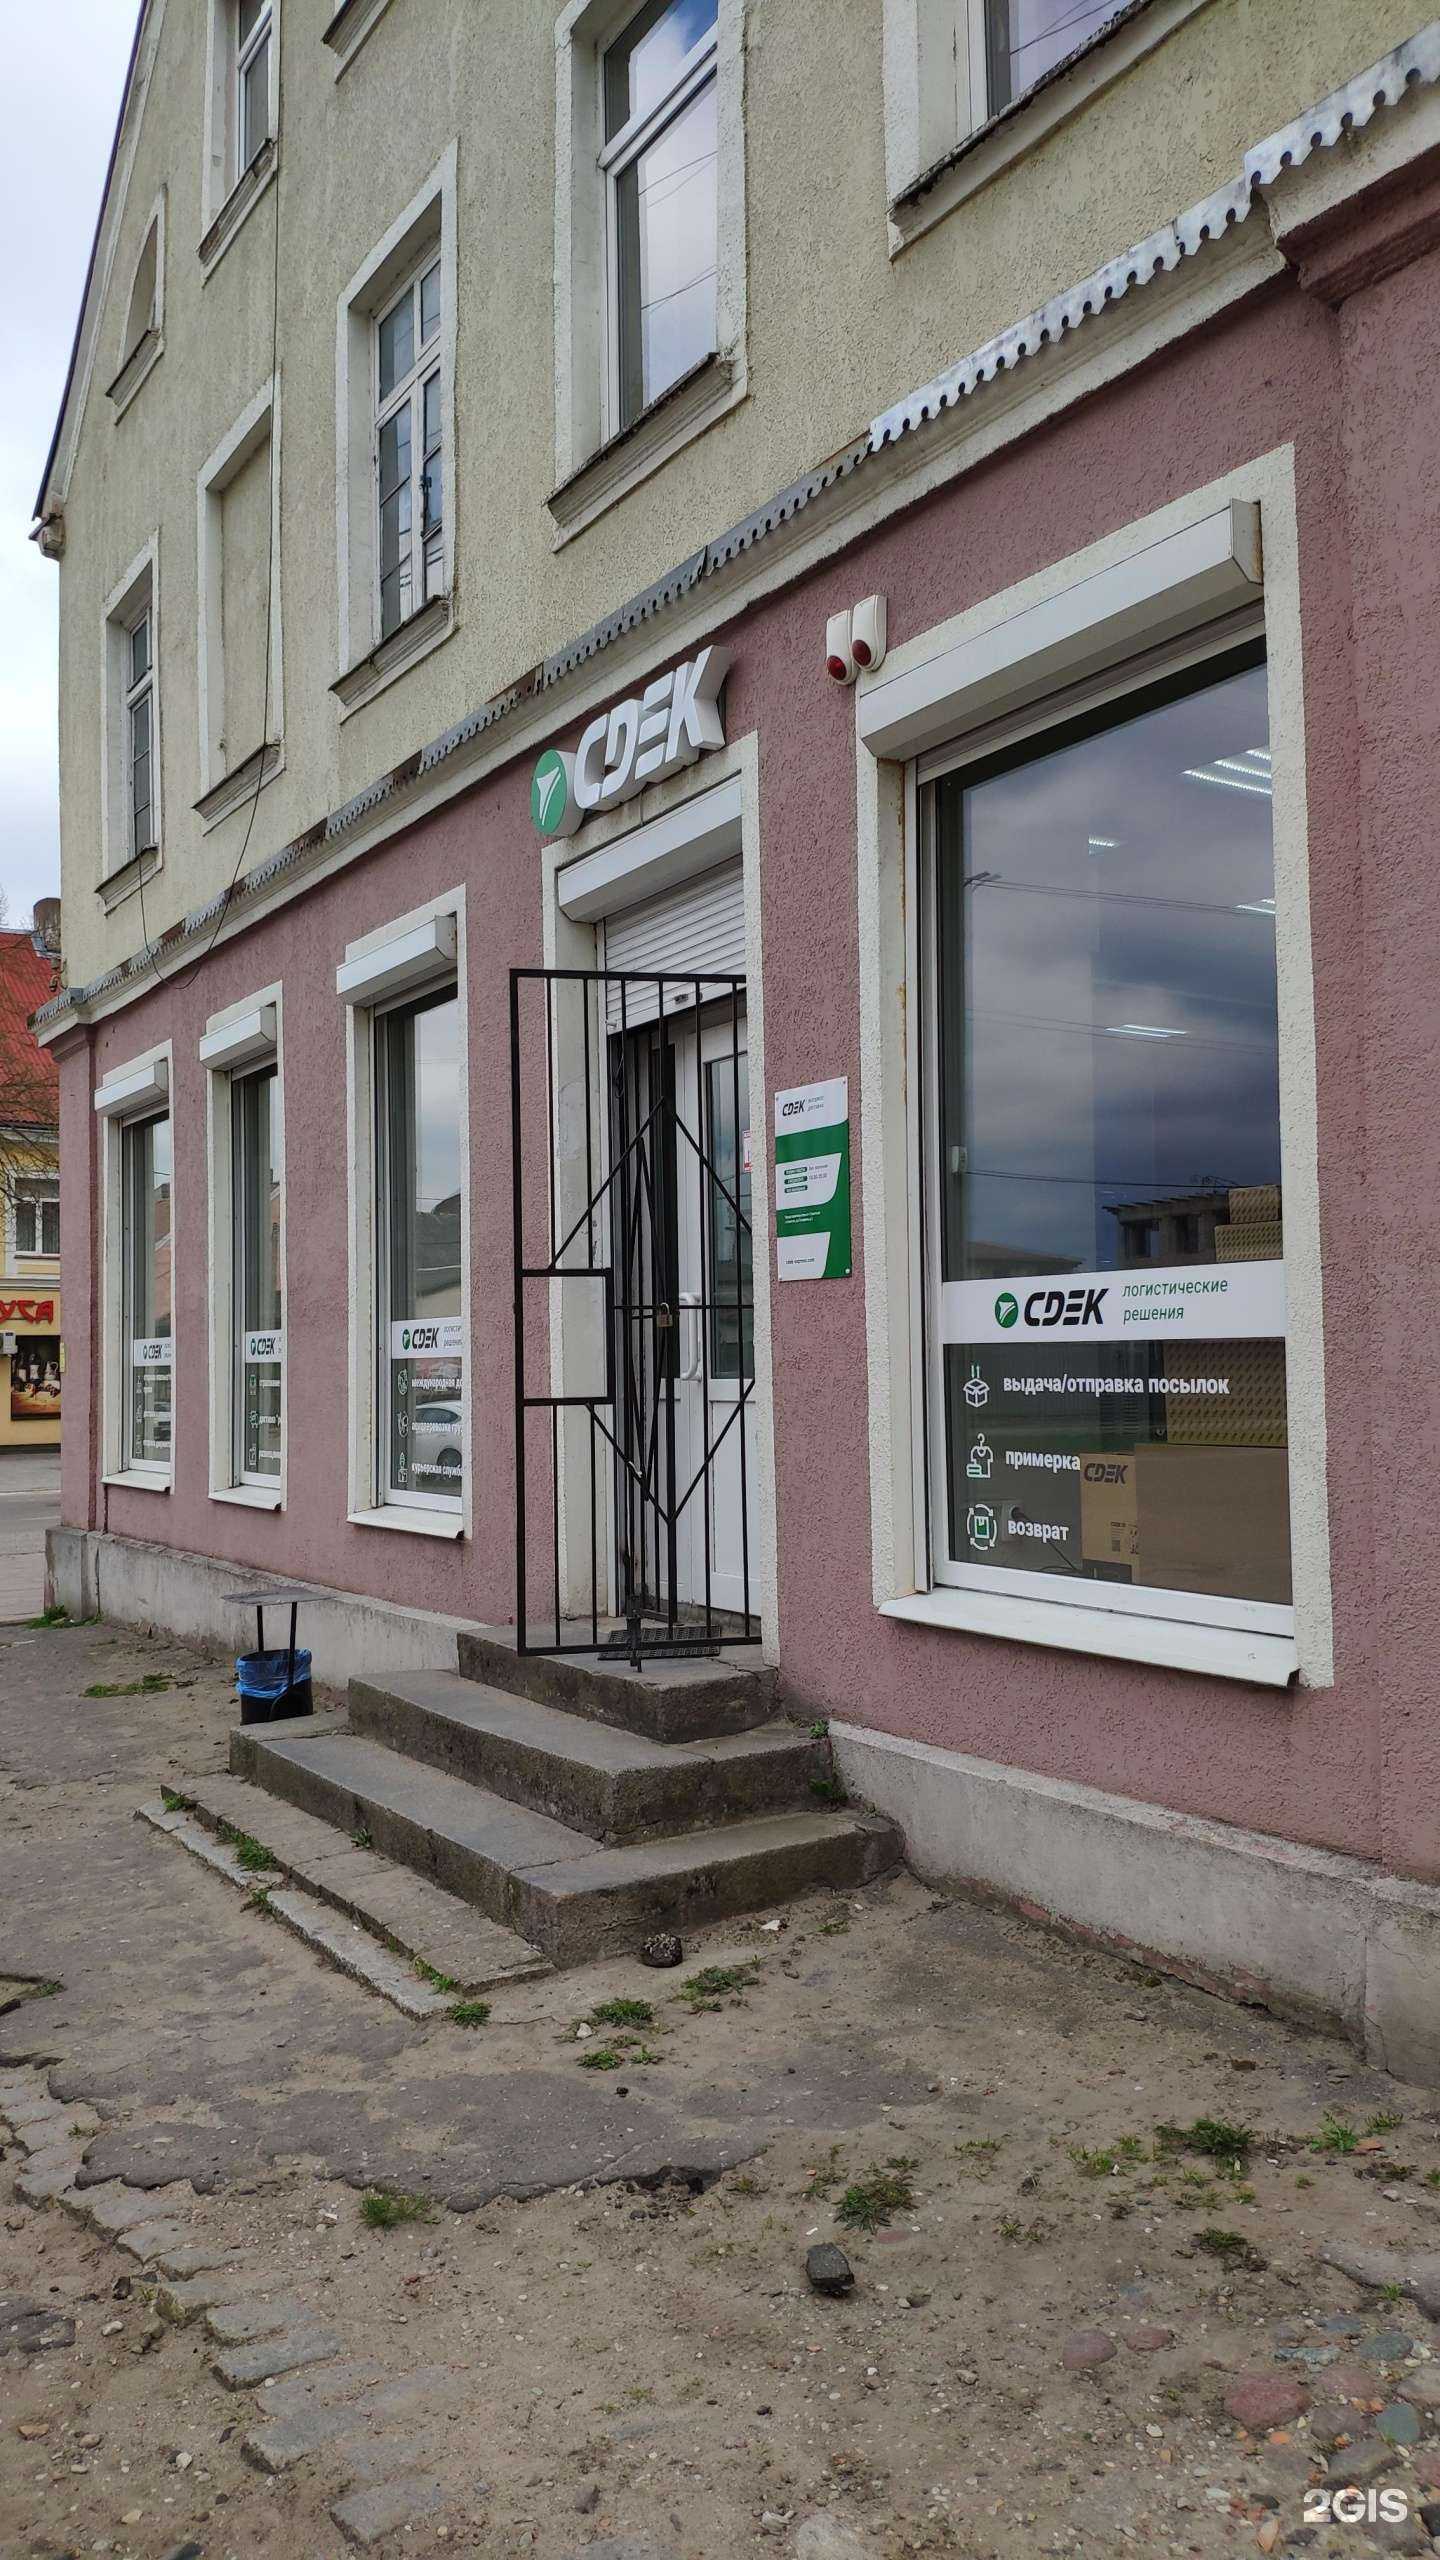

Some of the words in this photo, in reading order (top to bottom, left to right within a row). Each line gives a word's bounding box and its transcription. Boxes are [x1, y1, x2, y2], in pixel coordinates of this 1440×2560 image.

[574, 644, 728, 810] CDEK
[782, 1099, 806, 1117] CDEK
[1122, 1279, 1229, 1298] логистические
[1024, 1288, 1110, 1327] CDEK
[1123, 1306, 1185, 1324] решения
[257, 1336, 276, 1355] CDEK
[411, 1327, 439, 1349] CDEK
[148, 1344, 163, 1359] CDEK
[1003, 1374, 1144, 1397] выдача/отправка
[1148, 1376, 1231, 1394] посылок
[1005, 1449, 1081, 1473] примерка
[1084, 1462, 1129, 1485] CDEK
[1007, 1520, 1070, 1542] возврат
